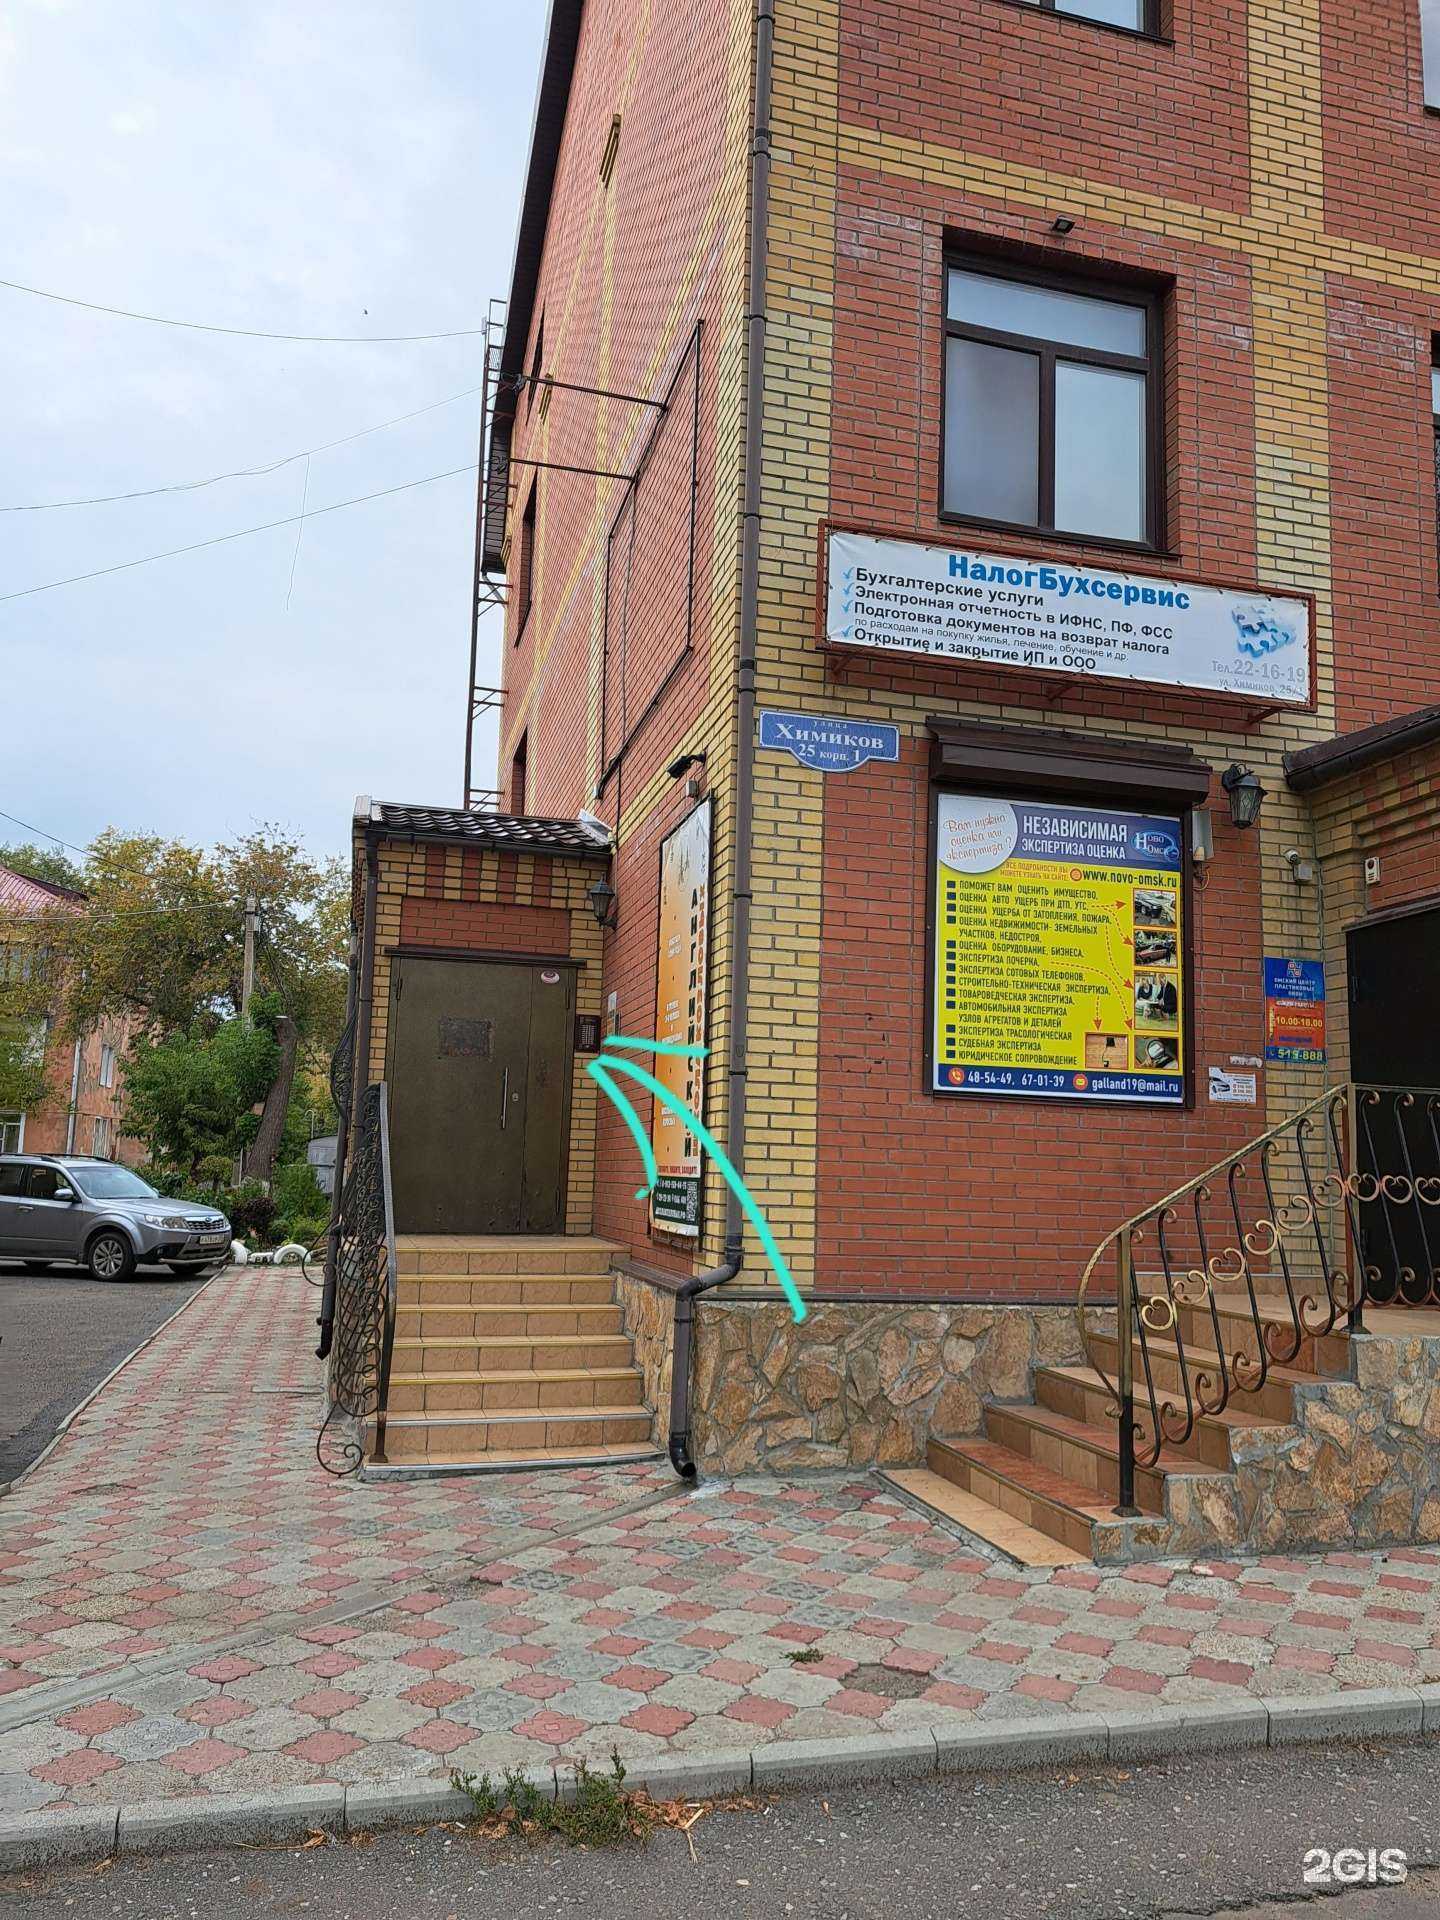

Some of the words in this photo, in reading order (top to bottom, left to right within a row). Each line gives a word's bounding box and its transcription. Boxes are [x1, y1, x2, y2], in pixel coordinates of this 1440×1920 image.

[856, 568, 983, 598] Бухгалтерские
[988, 589, 1044, 607] услуги
[949, 555, 1190, 609] НалогБухсервис
[855, 586, 954, 610] Электронная
[959, 603, 1042, 622] отчетность
[1047, 614, 1055, 623] в
[1060, 613, 1106, 632] ИФНС,
[1111, 621, 1137, 635] ПФ,
[1141, 625, 1173, 640] ФСС
[854, 602, 942, 625] Подготовка
[946, 618, 1036, 637] документов
[1040, 630, 1057, 640] на
[1062, 632, 1118, 648] возврат
[1122, 642, 1170, 655] налога
[855, 617, 867, 626] по
[870, 621, 919, 634] расходам
[922, 627, 934, 635] на
[937, 629, 975, 642] покупку
[977, 634, 1011, 646] жилья,
[1013, 639, 1057, 652] лечение,
[1059, 644, 1104, 657] обучение
[1106, 650, 1112, 658] и
[1114, 652, 1129, 662] др.
[854, 628, 930, 649] Открытие
[935, 640, 944, 650] и
[948, 642, 1019, 661] закрытие
[1023, 650, 1045, 663] ИП
[1049, 656, 1058, 665] и
[1062, 655, 1096, 669] ООО
[775, 723, 884, 749] Химиков
[798, 743, 816, 757] 25
[819, 751, 850, 763] корп.
[853, 750, 860, 761] 1
[1023, 816, 1128, 843] НЕЗАВИСИМАЯ
[950, 830, 984, 847] оценка
[1021, 838, 1085, 856] ЭКСПЕРТИЗА
[1086, 844, 1126, 860] ОЦЕНКА
[1082, 870, 1177, 888] www.novo-omsk.ru
[959, 880, 995, 892] ПОМОЖЕТ
[997, 883, 1013, 892] ВАМ
[1017, 885, 1049, 896] ОЦЕНИТЬ
[959, 892, 987, 902] ОЦЕНКА
[991, 895, 1010, 905] АВТО
[1014, 896, 1039, 907] УЩЕРБ
[1040, 898, 1055, 907] ПРИ
[959, 904, 987, 914] ОЦЕНКА
[991, 906, 1020, 917] УЩЕРБА
[1022, 908, 1032, 918] ОТ
[959, 916, 987, 926] ОЦЕНКА
[1054, 924, 1098, 935] ЗЕМЕЛЬНЫХ
[959, 940, 987, 950] ОЦЕНКА
[958, 952, 1004, 964] ЭКСПЕРТИЗА
[958, 964, 1004, 976] ЭКСПЕРТИЗА
[1006, 967, 1039, 978] СОТОВЫХ
[958, 978, 1061, 992] СТРОИТЕЛЬНО-ТЕХНИЧЕСКАЯ
[958, 989, 1027, 1001] ТОВАРОВЕДЧЕСКАЯ
[958, 1002, 1021, 1013] АВТОМОБИЛЬНАЯ
[1023, 1005, 1068, 1016] ЭКСПЕРТИЗА
[684, 888, 698, 1158] АНГЛИЙСКЙ
[958, 1014, 982, 1024] УЗЛОВ
[984, 1015, 1021, 1026] АГРЕГАТОВ
[1023, 1018, 1029, 1026] И
[1031, 1017, 1062, 1029] ДЕТАЛЕЙ
[1276, 1016, 1323, 1028] 10.00-18.00
[958, 1026, 1004, 1037] ЭКСПЕРТИЗА
[1006, 1028, 1072, 1041] ТРАСОЛОГИЧЕСКАЯ
[958, 1039, 995, 1049] СУДЕБНАЯ
[997, 1040, 1042, 1051] ЭКСПЕРТИЗА
[958, 1050, 1013, 1062] ЮРИДИЧЕСКОЕ
[1015, 1053, 1078, 1065] СОПРОВОЖДЕНИЕ
[1021, 1073, 1065, 1087] 67-01-39
[1092, 1077, 1179, 1093] galland19@mail.ru
